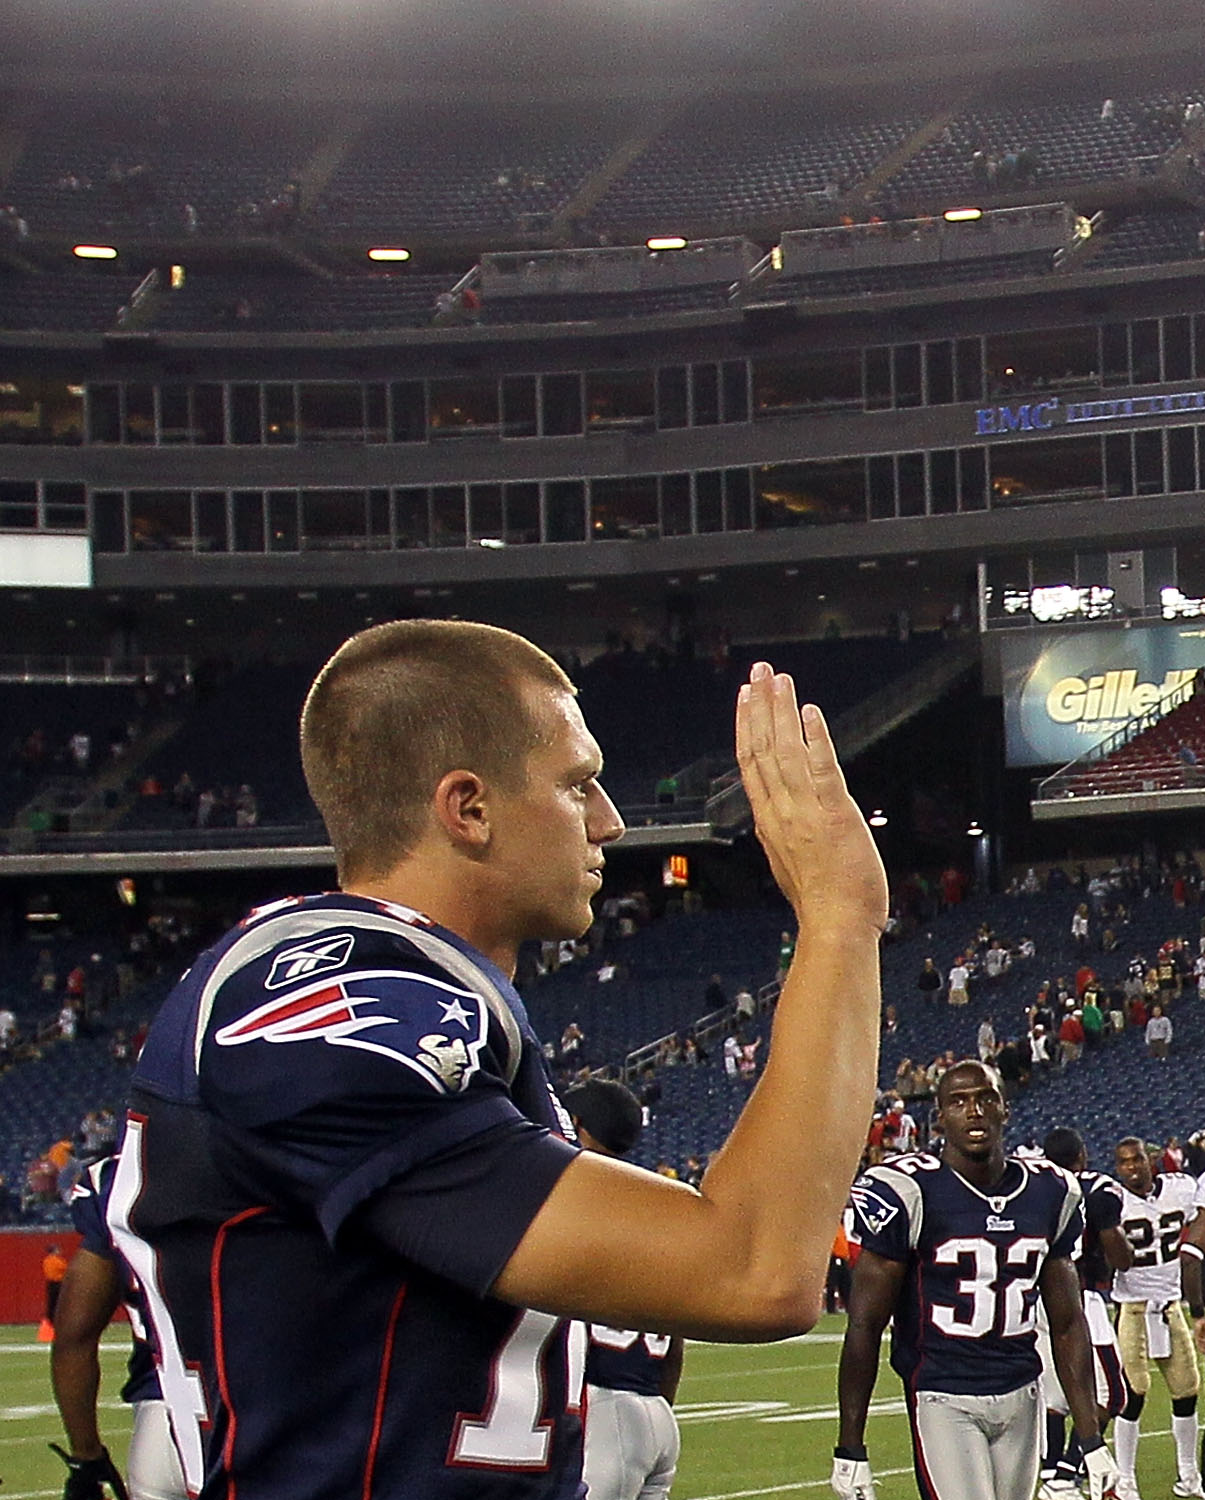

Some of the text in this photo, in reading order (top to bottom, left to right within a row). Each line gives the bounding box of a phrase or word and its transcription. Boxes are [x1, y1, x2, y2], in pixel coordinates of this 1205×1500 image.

[1045, 668, 1200, 724] Gillett
[1122, 1209, 1186, 1268] 22
[930, 1235, 1050, 1339] 32
